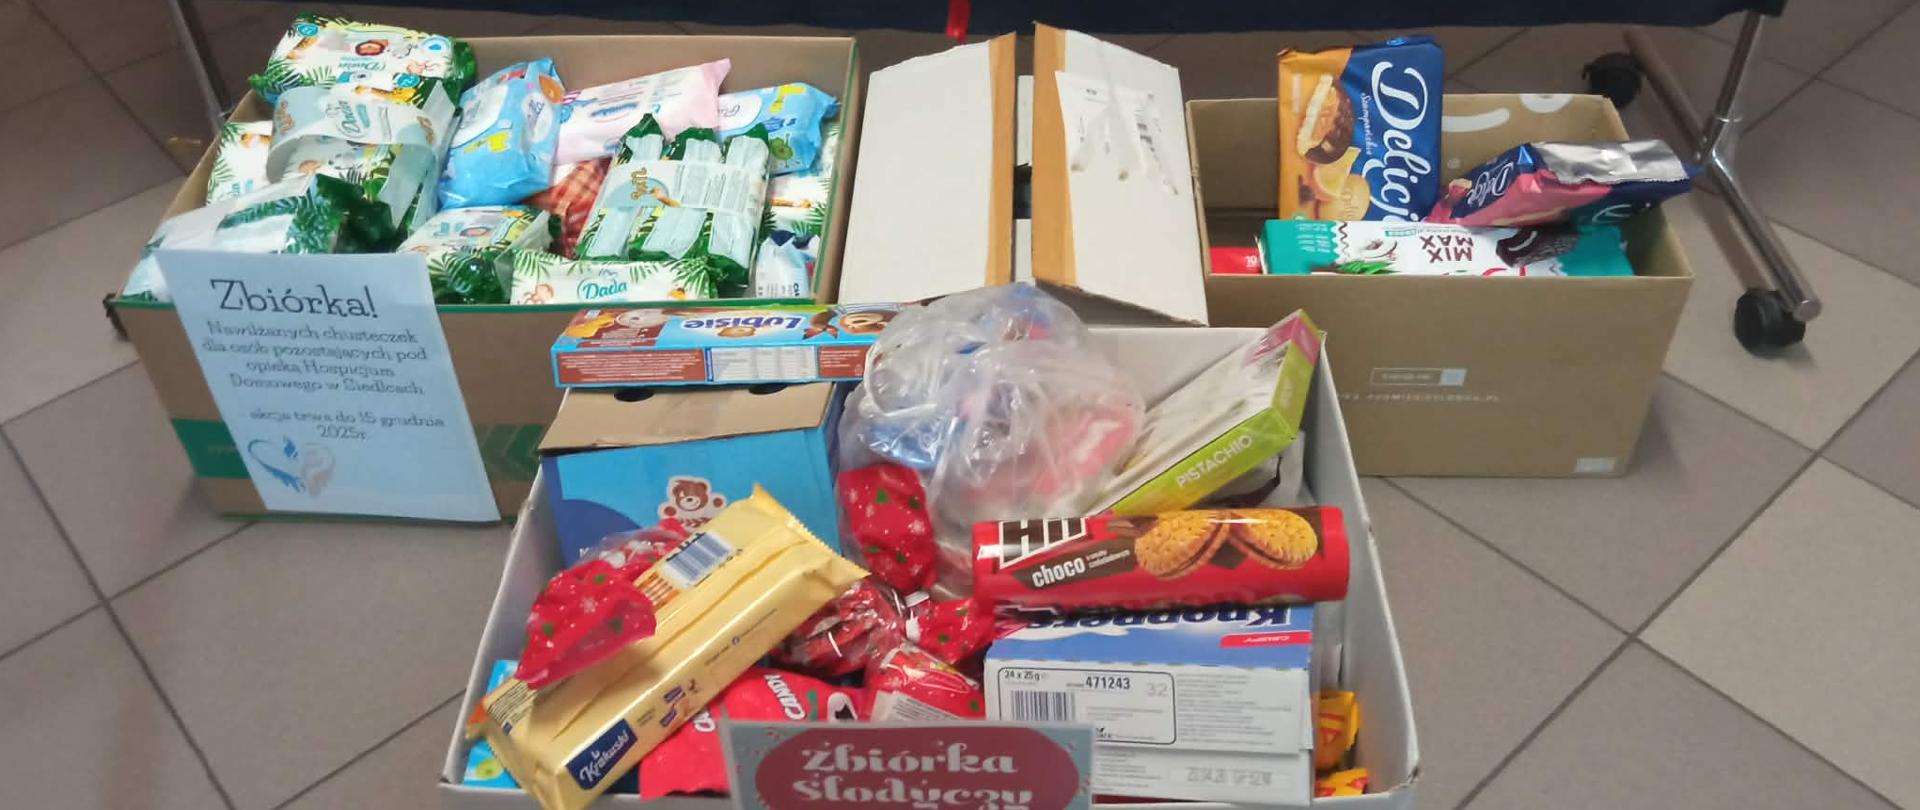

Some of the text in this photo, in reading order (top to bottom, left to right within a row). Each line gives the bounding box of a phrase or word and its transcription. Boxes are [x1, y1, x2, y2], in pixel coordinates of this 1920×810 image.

[1419, 234, 1474, 250] MAX
[1428, 246, 1472, 264] MIX
[210, 278, 378, 318] Zbiórka!
[582, 281, 628, 300] Dada
[682, 315, 803, 330] Lubisie
[202, 340, 226, 351] dla
[397, 347, 428, 362] pod
[335, 410, 356, 423] do
[1175, 434, 1253, 487] PISTACHIO
[1031, 557, 1086, 588] choco
[1085, 676, 1131, 690] 471243
[578, 730, 630, 783] Krakuski
